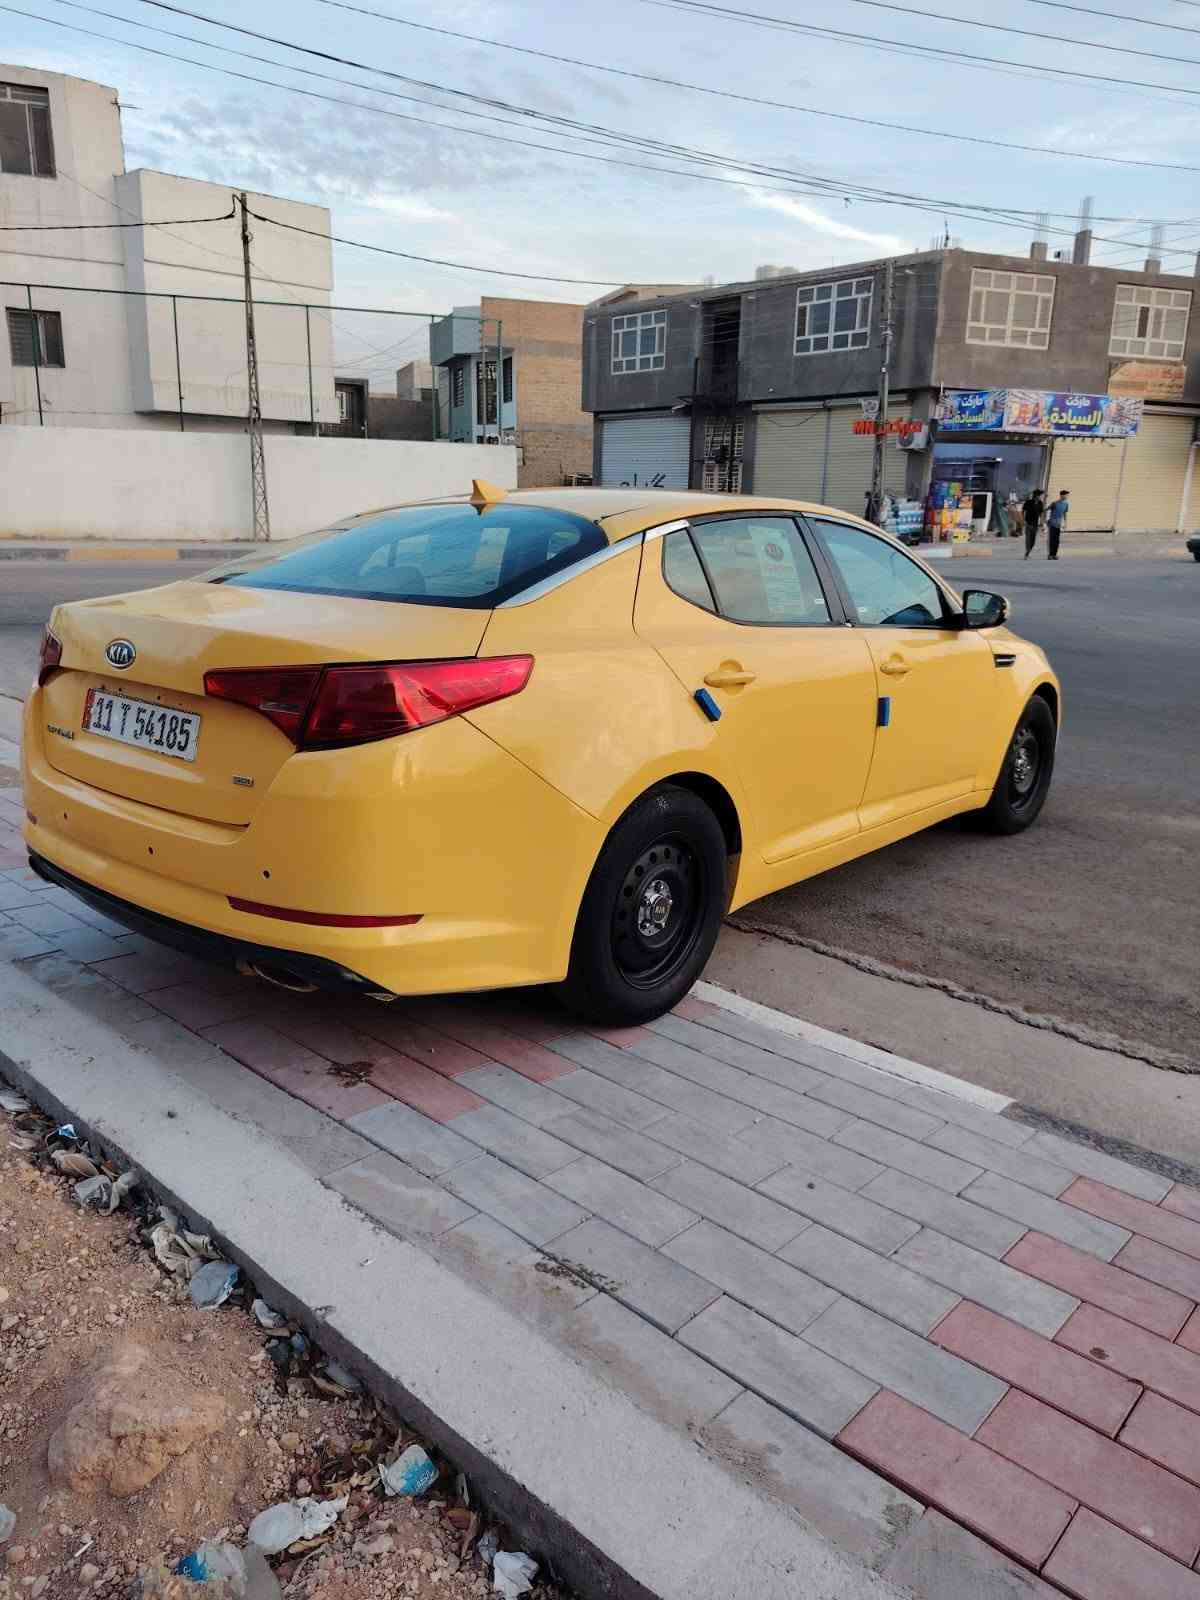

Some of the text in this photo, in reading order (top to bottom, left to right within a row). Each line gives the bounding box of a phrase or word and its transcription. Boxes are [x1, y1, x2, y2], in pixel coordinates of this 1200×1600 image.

[1051, 407, 1101, 429] السيادة
[109, 645, 129, 662] KIA
[92, 697, 113, 732] 11
[120, 702, 131, 736] T
[134, 707, 192, 752] 54185
